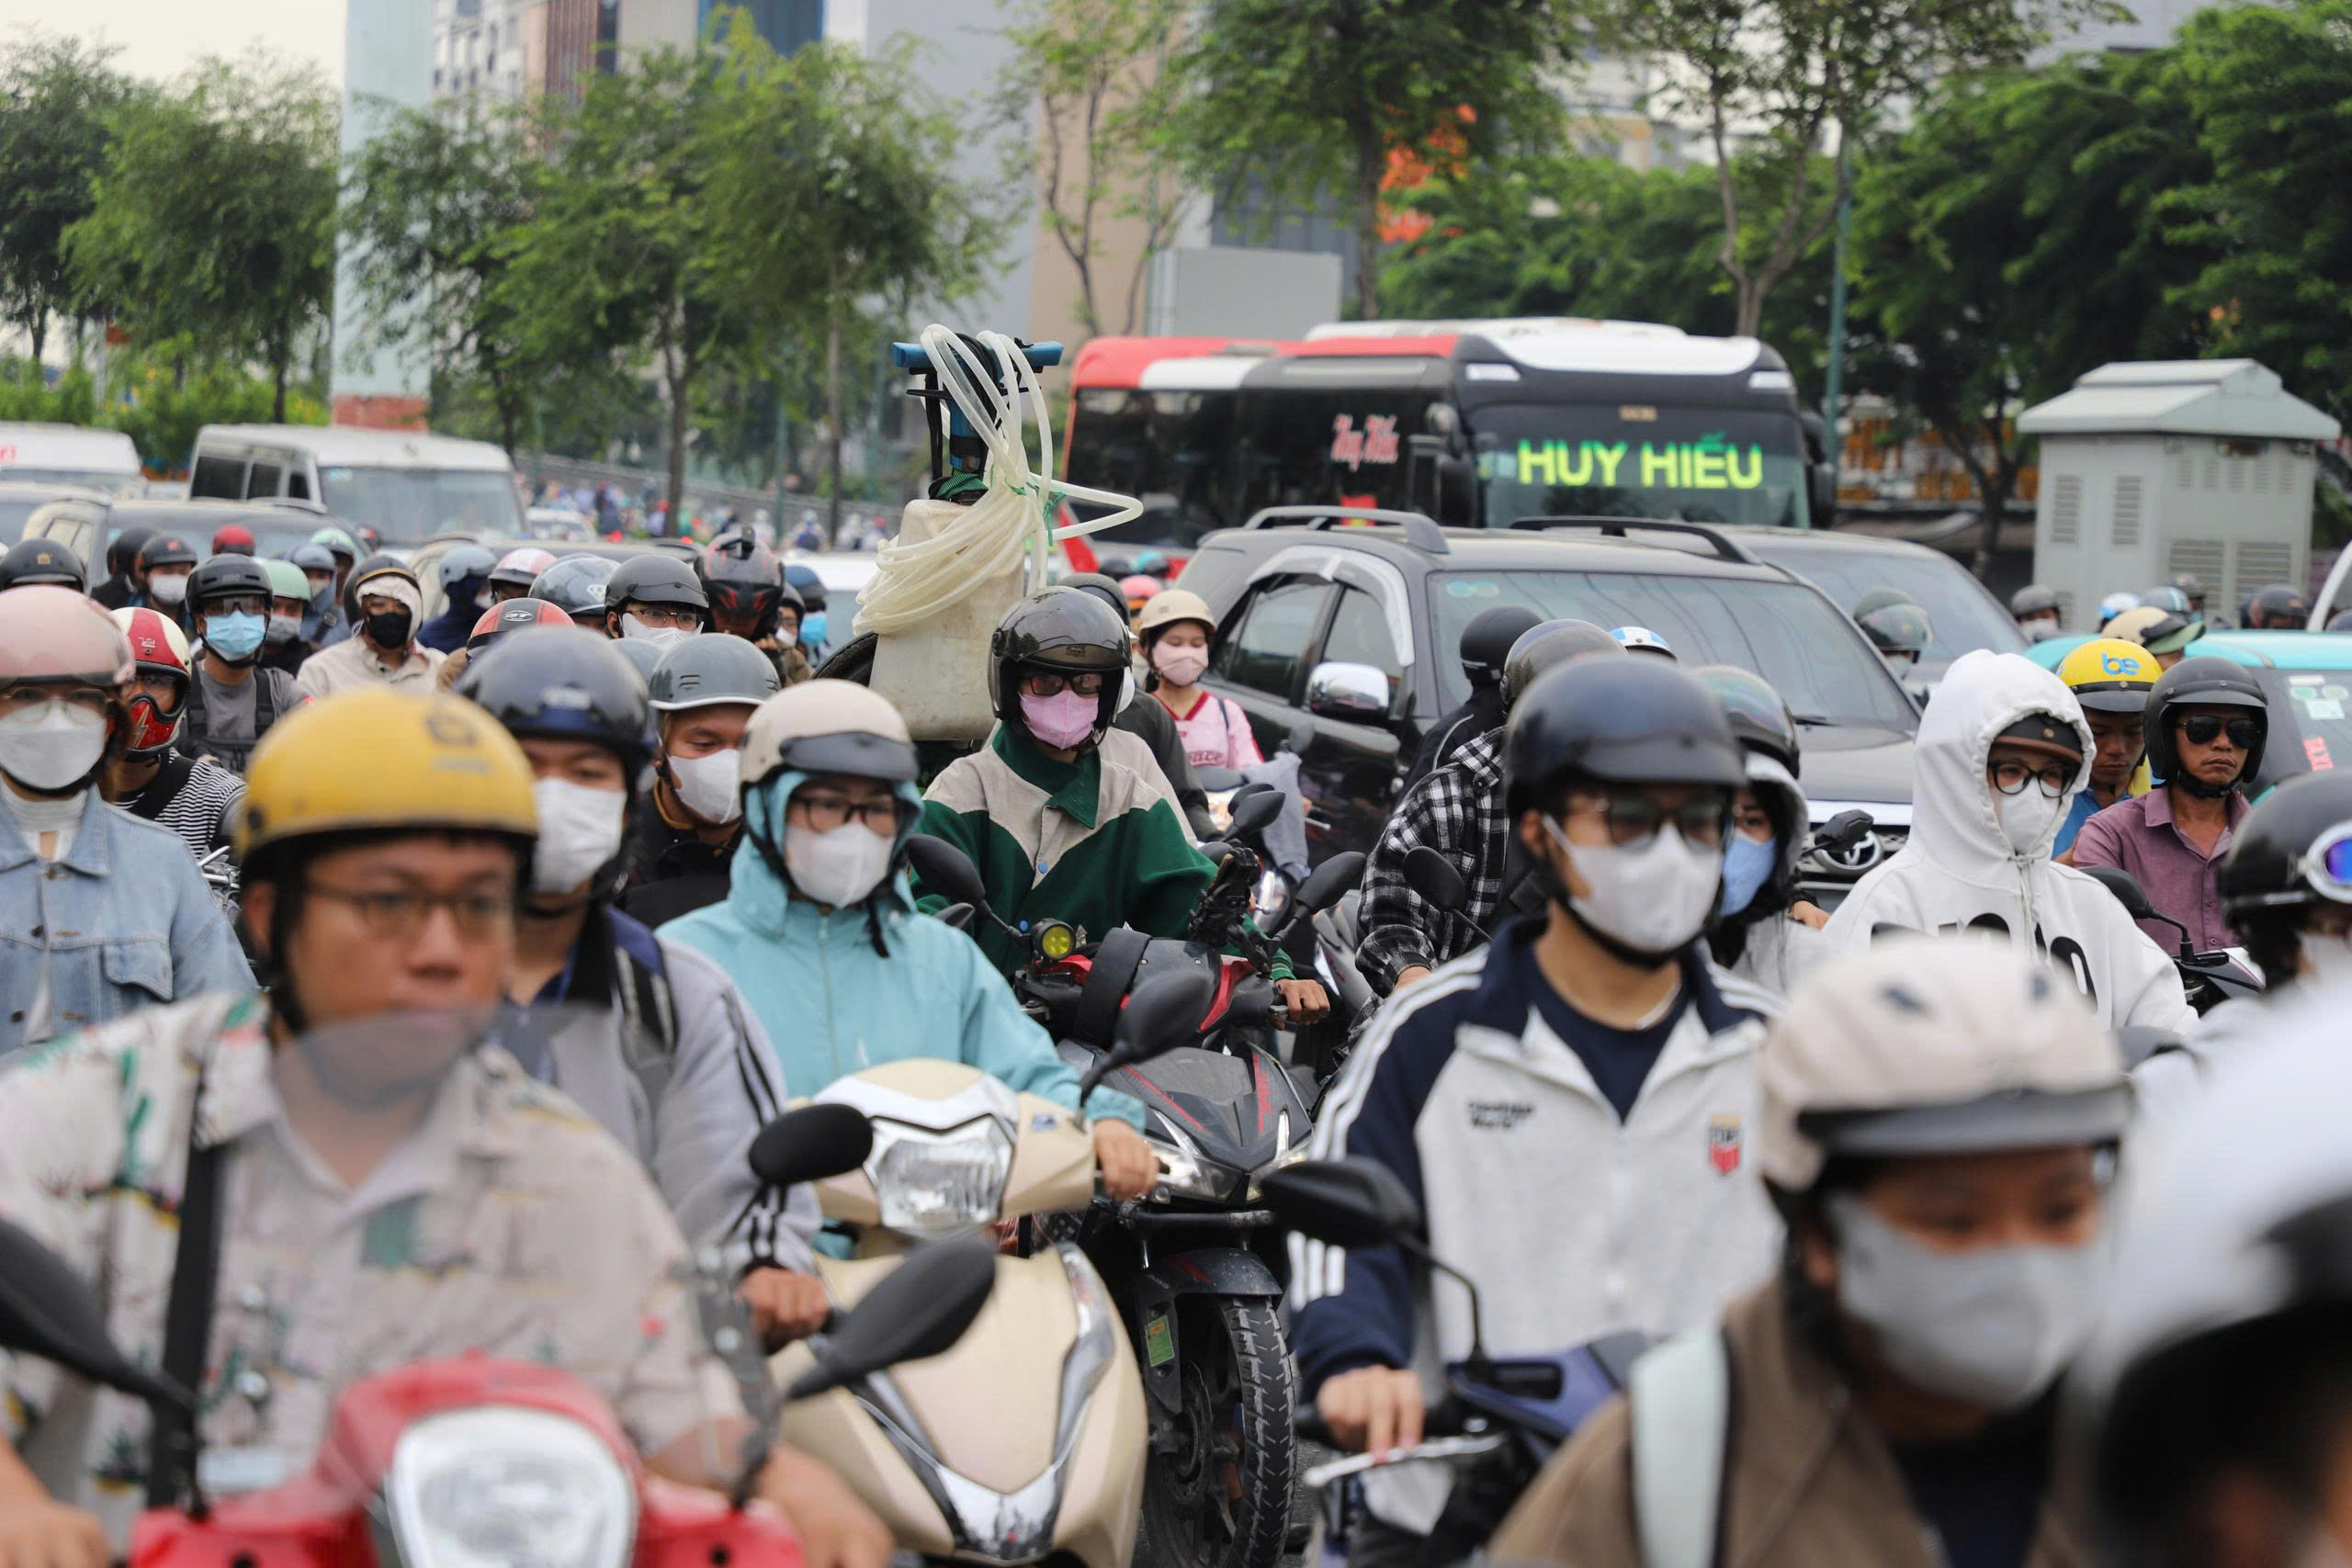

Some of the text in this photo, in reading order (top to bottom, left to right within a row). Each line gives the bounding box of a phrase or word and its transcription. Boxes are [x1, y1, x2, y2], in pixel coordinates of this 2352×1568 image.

[1517, 429, 1764, 490] HUY HIẾU
[2101, 653, 2141, 675] be
